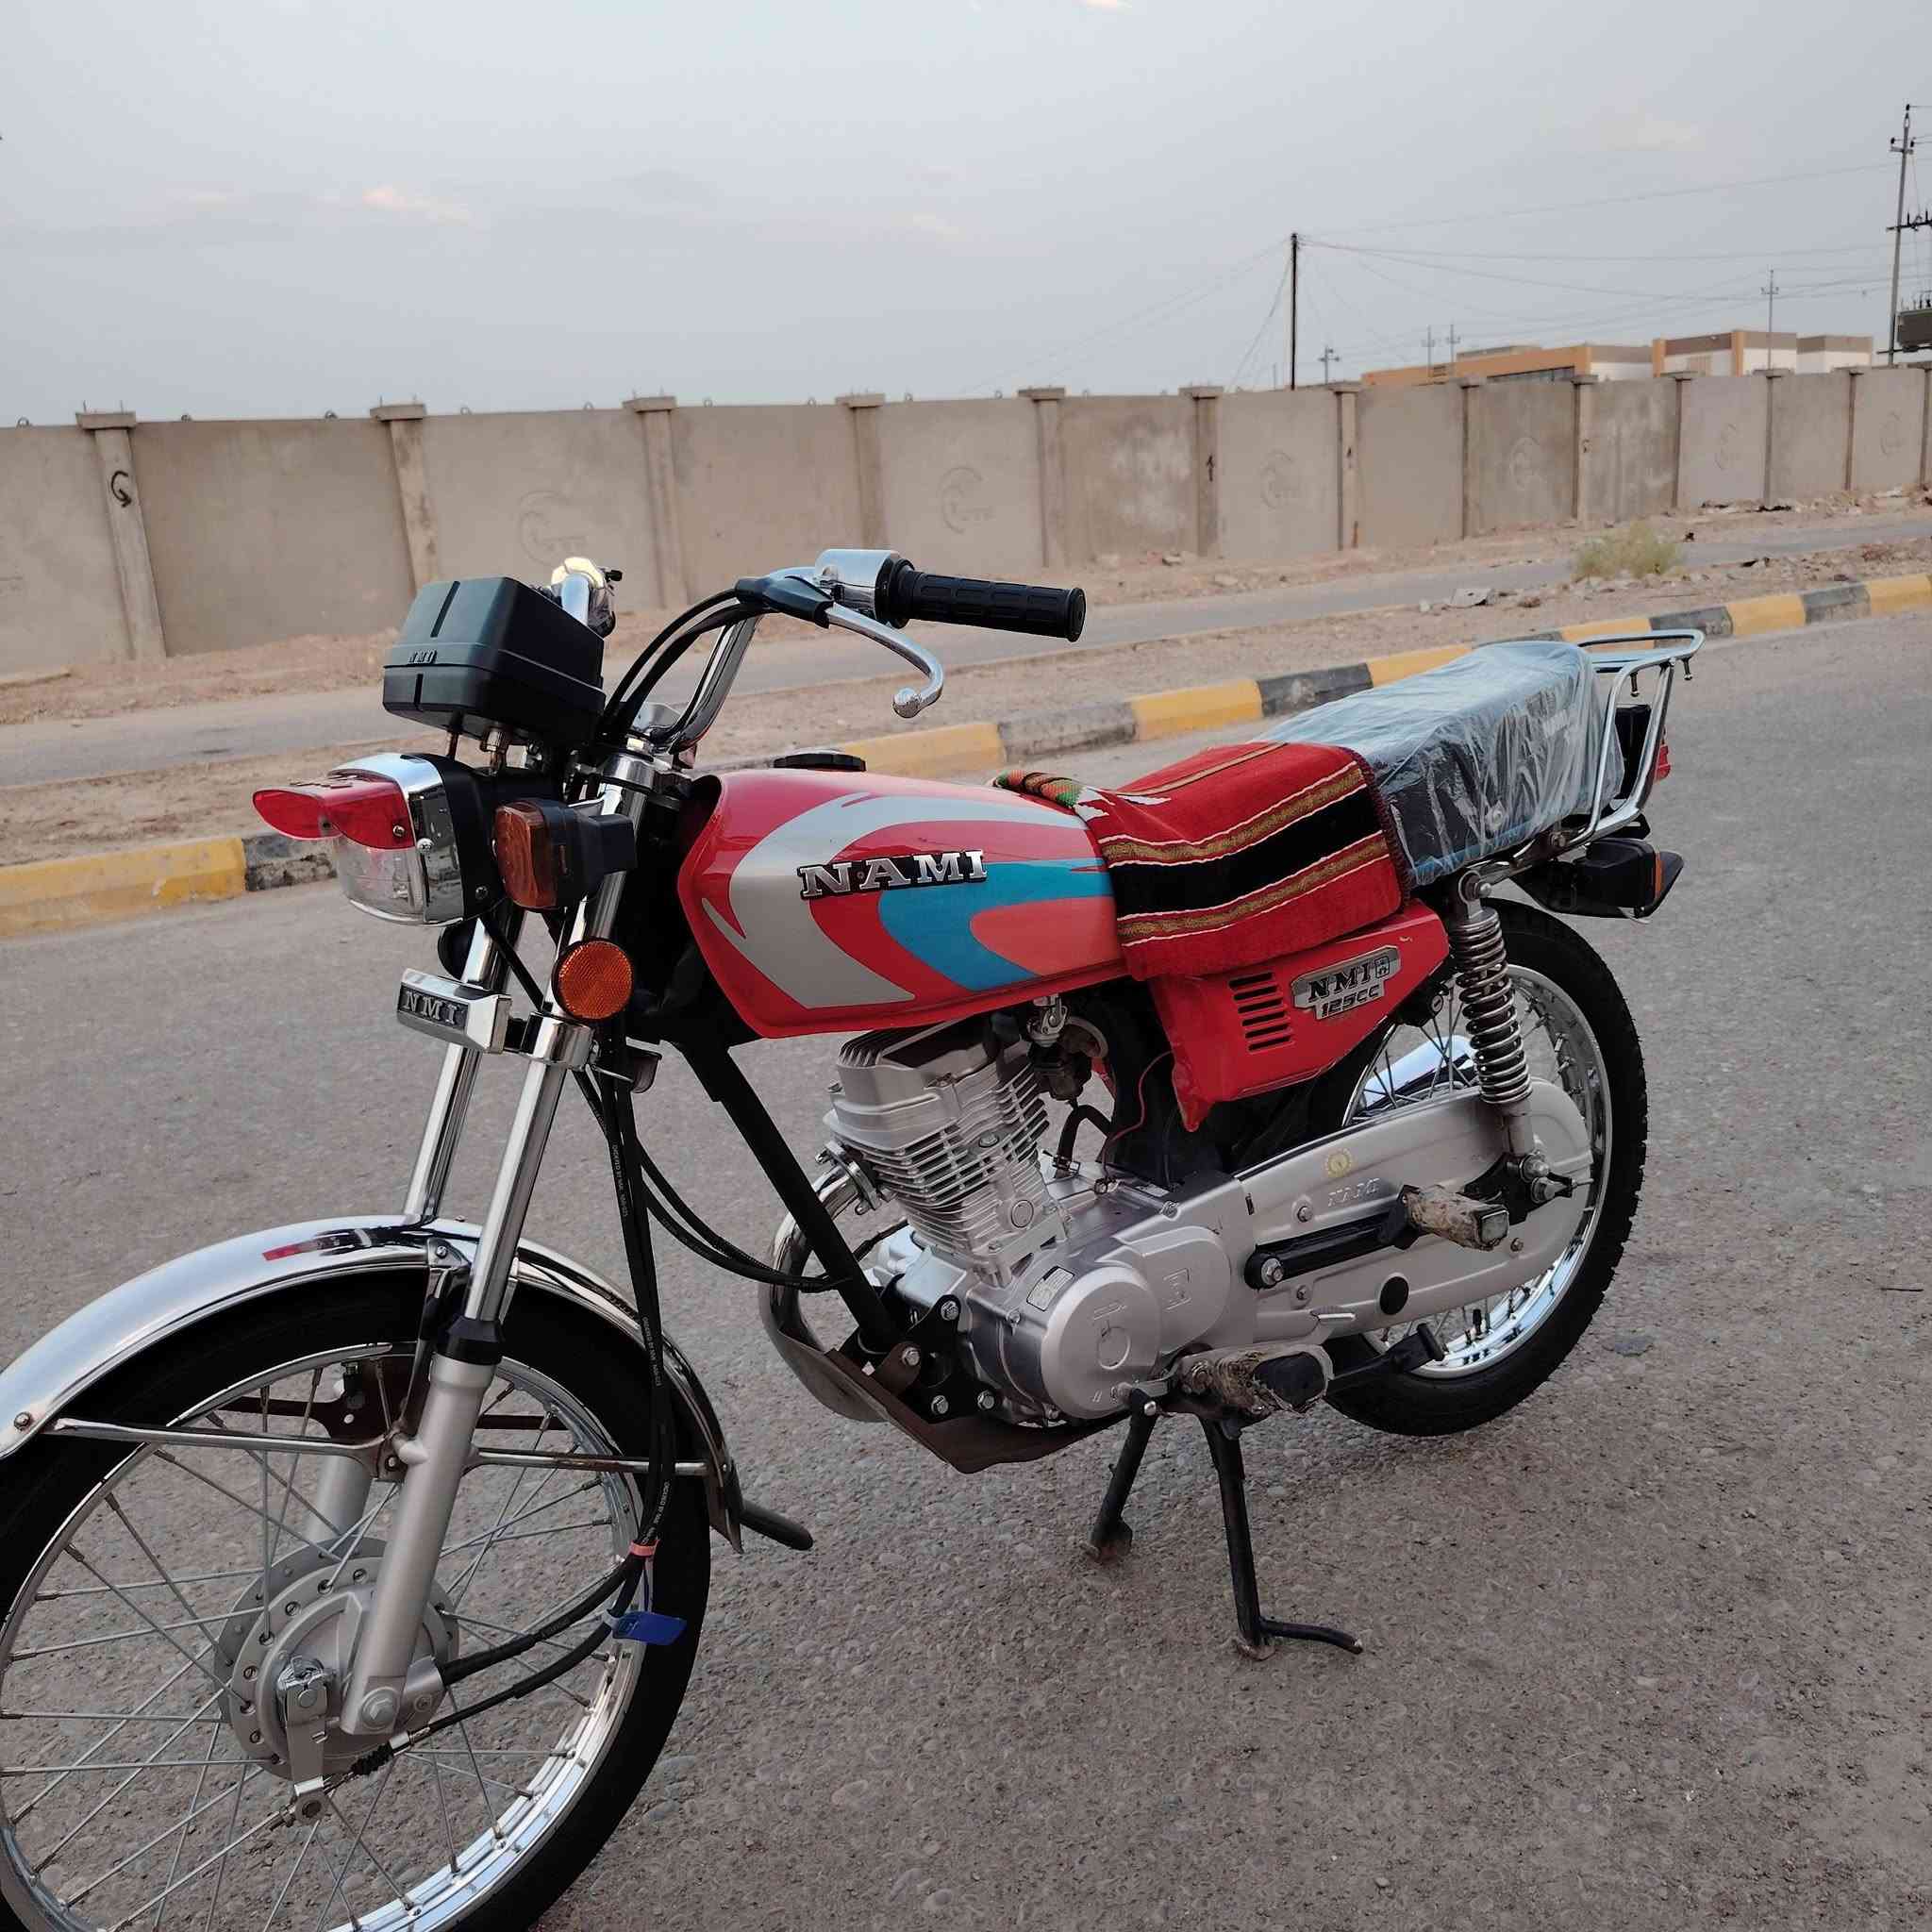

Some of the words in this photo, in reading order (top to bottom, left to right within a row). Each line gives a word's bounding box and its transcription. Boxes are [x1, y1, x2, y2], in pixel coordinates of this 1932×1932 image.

[797, 848, 988, 899] NAMI
[1307, 963, 1371, 1002] NMI
[403, 991, 458, 1024] NMI
